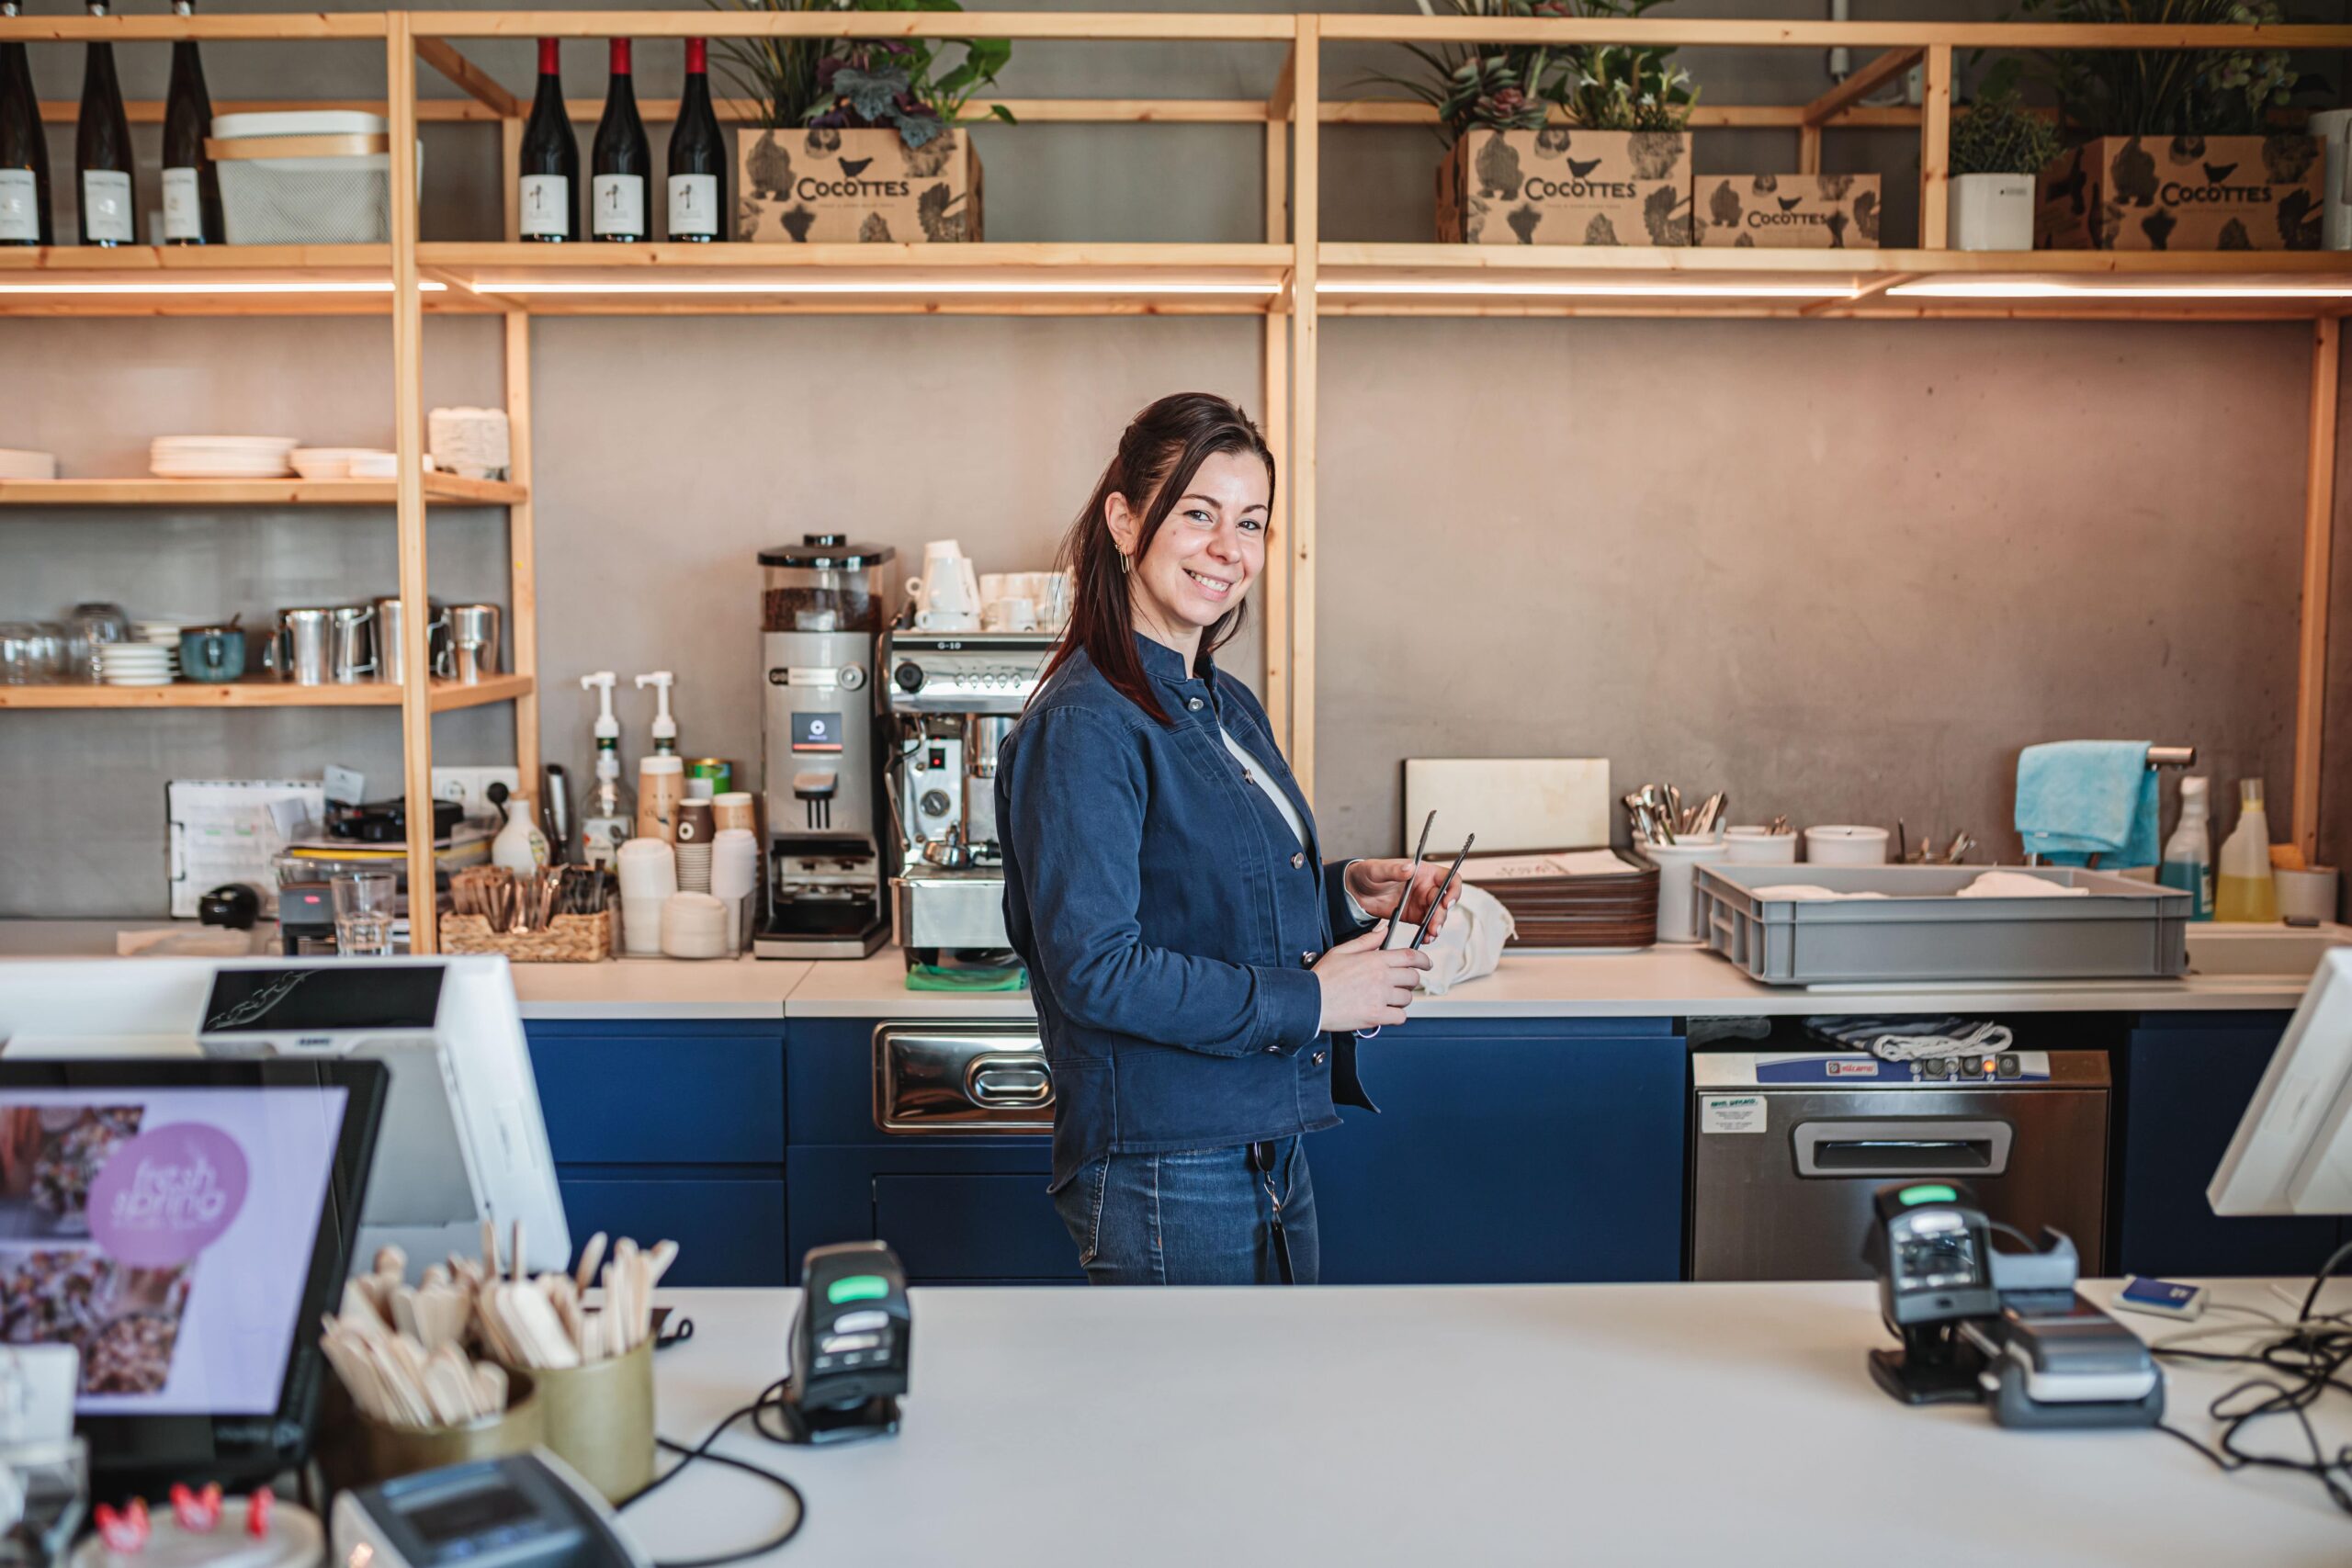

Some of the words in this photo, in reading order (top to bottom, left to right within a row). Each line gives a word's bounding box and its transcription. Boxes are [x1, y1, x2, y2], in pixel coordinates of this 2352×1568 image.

[797, 177, 910, 201] COCOTTES
[1524, 176, 1636, 201] COCOTTES
[2161, 182, 2272, 206] COCOTTES
[1747, 210, 1827, 229] COCOTTES
